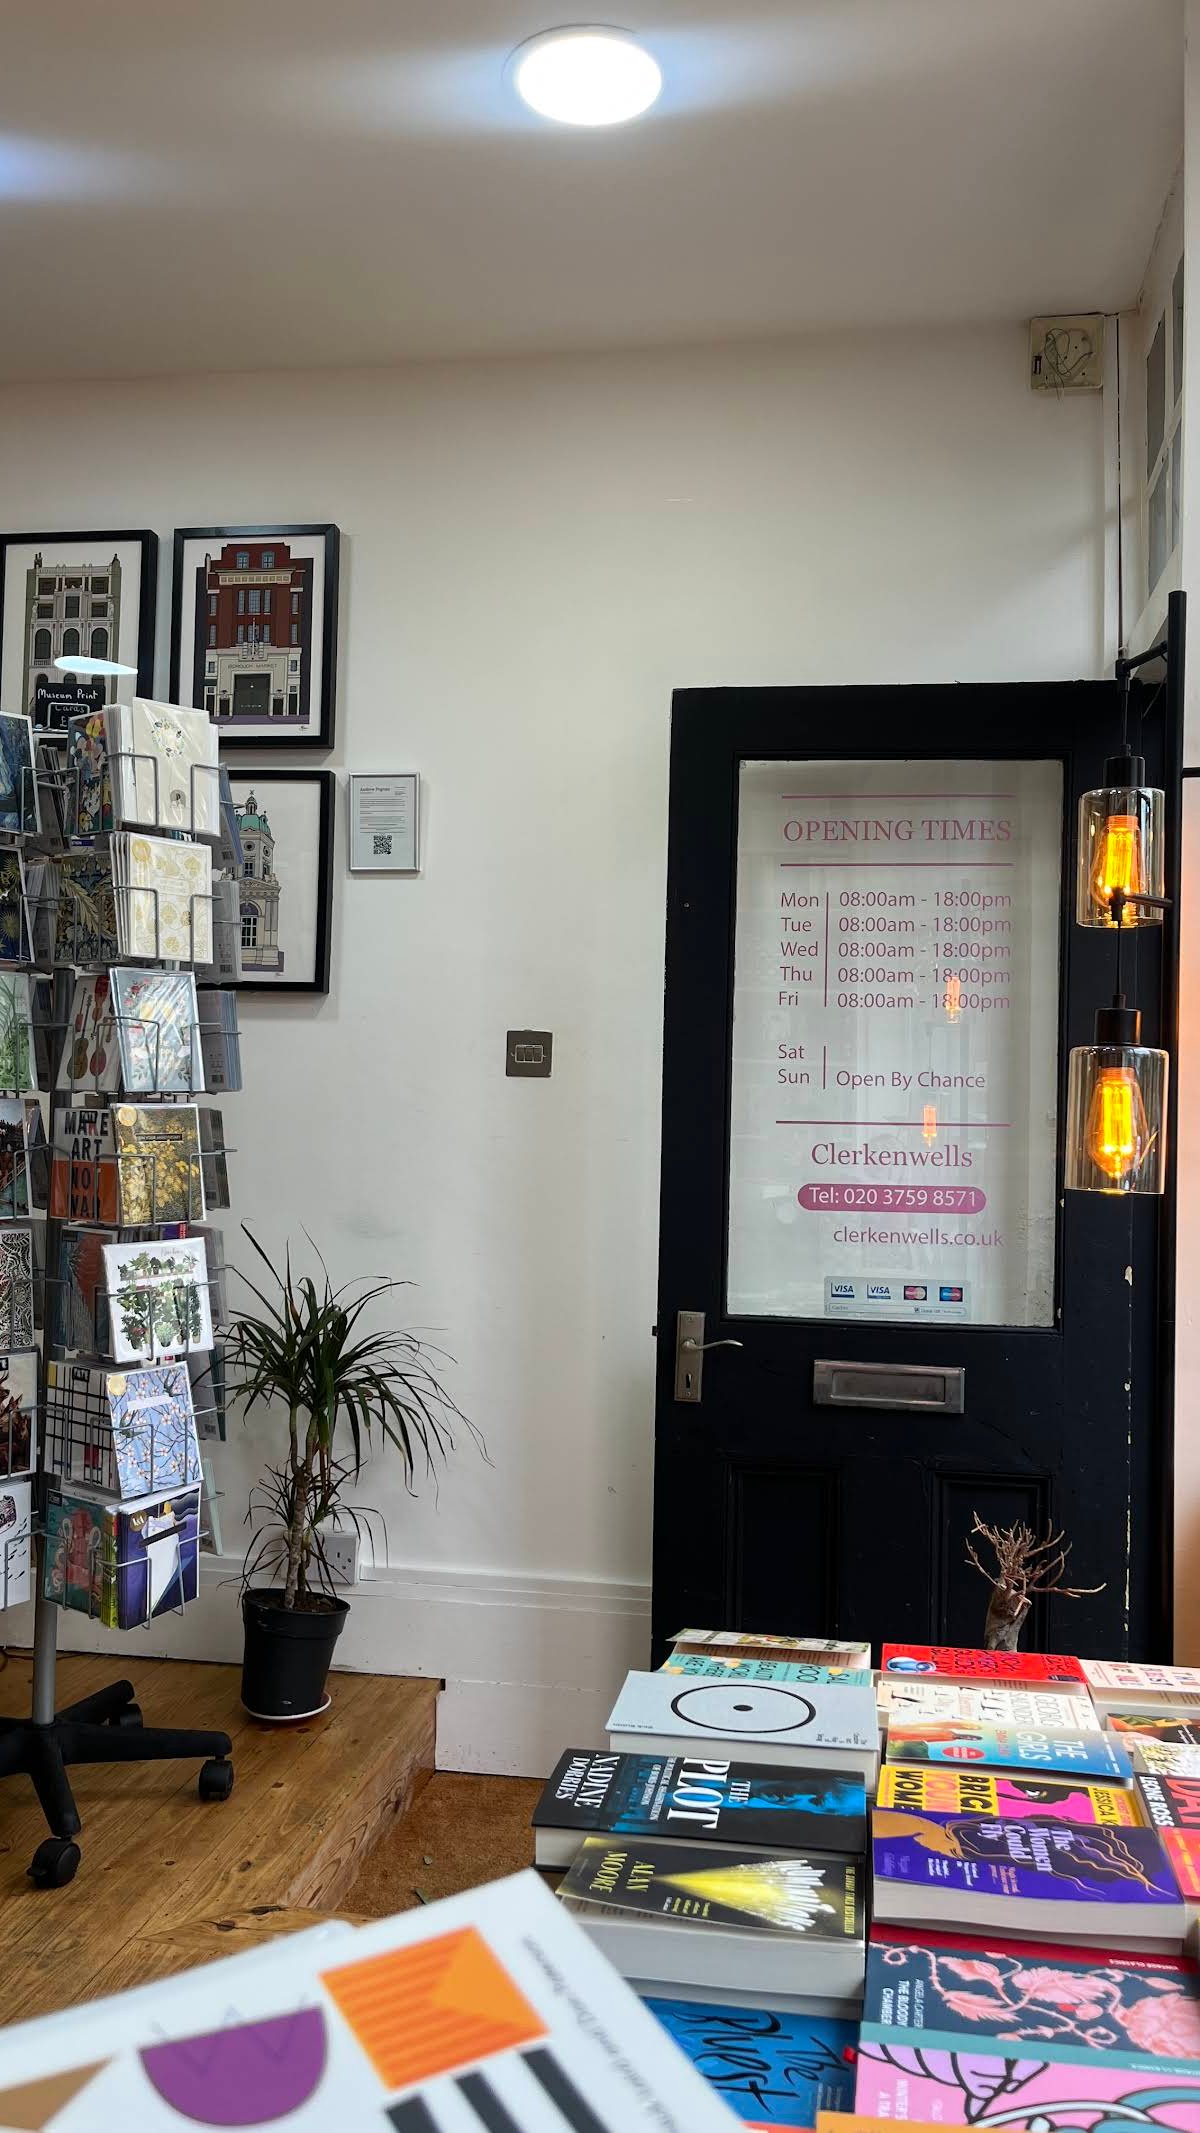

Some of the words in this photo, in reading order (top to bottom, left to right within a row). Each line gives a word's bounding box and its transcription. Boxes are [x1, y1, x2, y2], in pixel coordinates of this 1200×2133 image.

[37, 688, 72, 700] Museum
[77, 688, 98, 700] Print
[783, 820, 915, 841] OPENING
[921, 819, 1012, 841] TIMES
[780, 892, 819, 908] Mon
[839, 891, 915, 907] 08:00am
[934, 891, 1012, 910] 18:00pm
[780, 917, 812, 932] Tue
[838, 917, 915, 932] 08:00am
[933, 917, 1012, 936] 18:00pm
[780, 941, 819, 957] Wed
[838, 942, 914, 958] 08:00am
[933, 942, 1011, 961] 18:00pm
[779, 965, 813, 982] Thu
[837, 967, 914, 983] 08:00am
[932, 968, 1011, 987] 18:00pm
[778, 991, 799, 1006] Fri
[837, 993, 914, 1008] 08:00am
[932, 993, 1010, 1012] 18:00pm
[777, 1044, 805, 1060] Sat
[777, 1068, 810, 1084] Sun
[836, 1070, 885, 1089] Open
[891, 1071, 913, 1091] By
[917, 1071, 986, 1088] Chance
[71, 1137, 103, 1162] ART
[811, 1142, 973, 1168] Clerkenwells
[808, 1187, 839, 1204] Tel:
[844, 1188, 878, 1204] 020
[883, 1189, 928, 1206] 3759
[933, 1191, 976, 1207] 8571
[833, 1226, 1004, 1247] clerkenwells.co.uk
[834, 1284, 854, 1293] VISA
[870, 1286, 890, 1294] VISA
[1016, 1731, 1052, 1761] GIRLS
[1053, 1739, 1088, 1760] THE
[555, 1756, 591, 1800] DORRIES
[574, 1754, 620, 1809] NADINE
[1139, 1775, 1165, 1804] LEONE
[667, 1757, 731, 1830] PLOT
[729, 1780, 751, 1804] THE
[1093, 1786, 1111, 1816] JESSICA
[1150, 1803, 1176, 1828] ROSS
[977, 1822, 1003, 1841] Fly
[1050, 1826, 1075, 1851] The
[1004, 1825, 1033, 1863] Could
[1028, 1826, 1053, 1872] Women
[589, 1851, 627, 1894] MOORE
[626, 1860, 655, 1893] ALAN
[898, 1980, 910, 1994] THE
[914, 1978, 925, 2003] ANGELA
[775, 2036, 851, 2087] The
